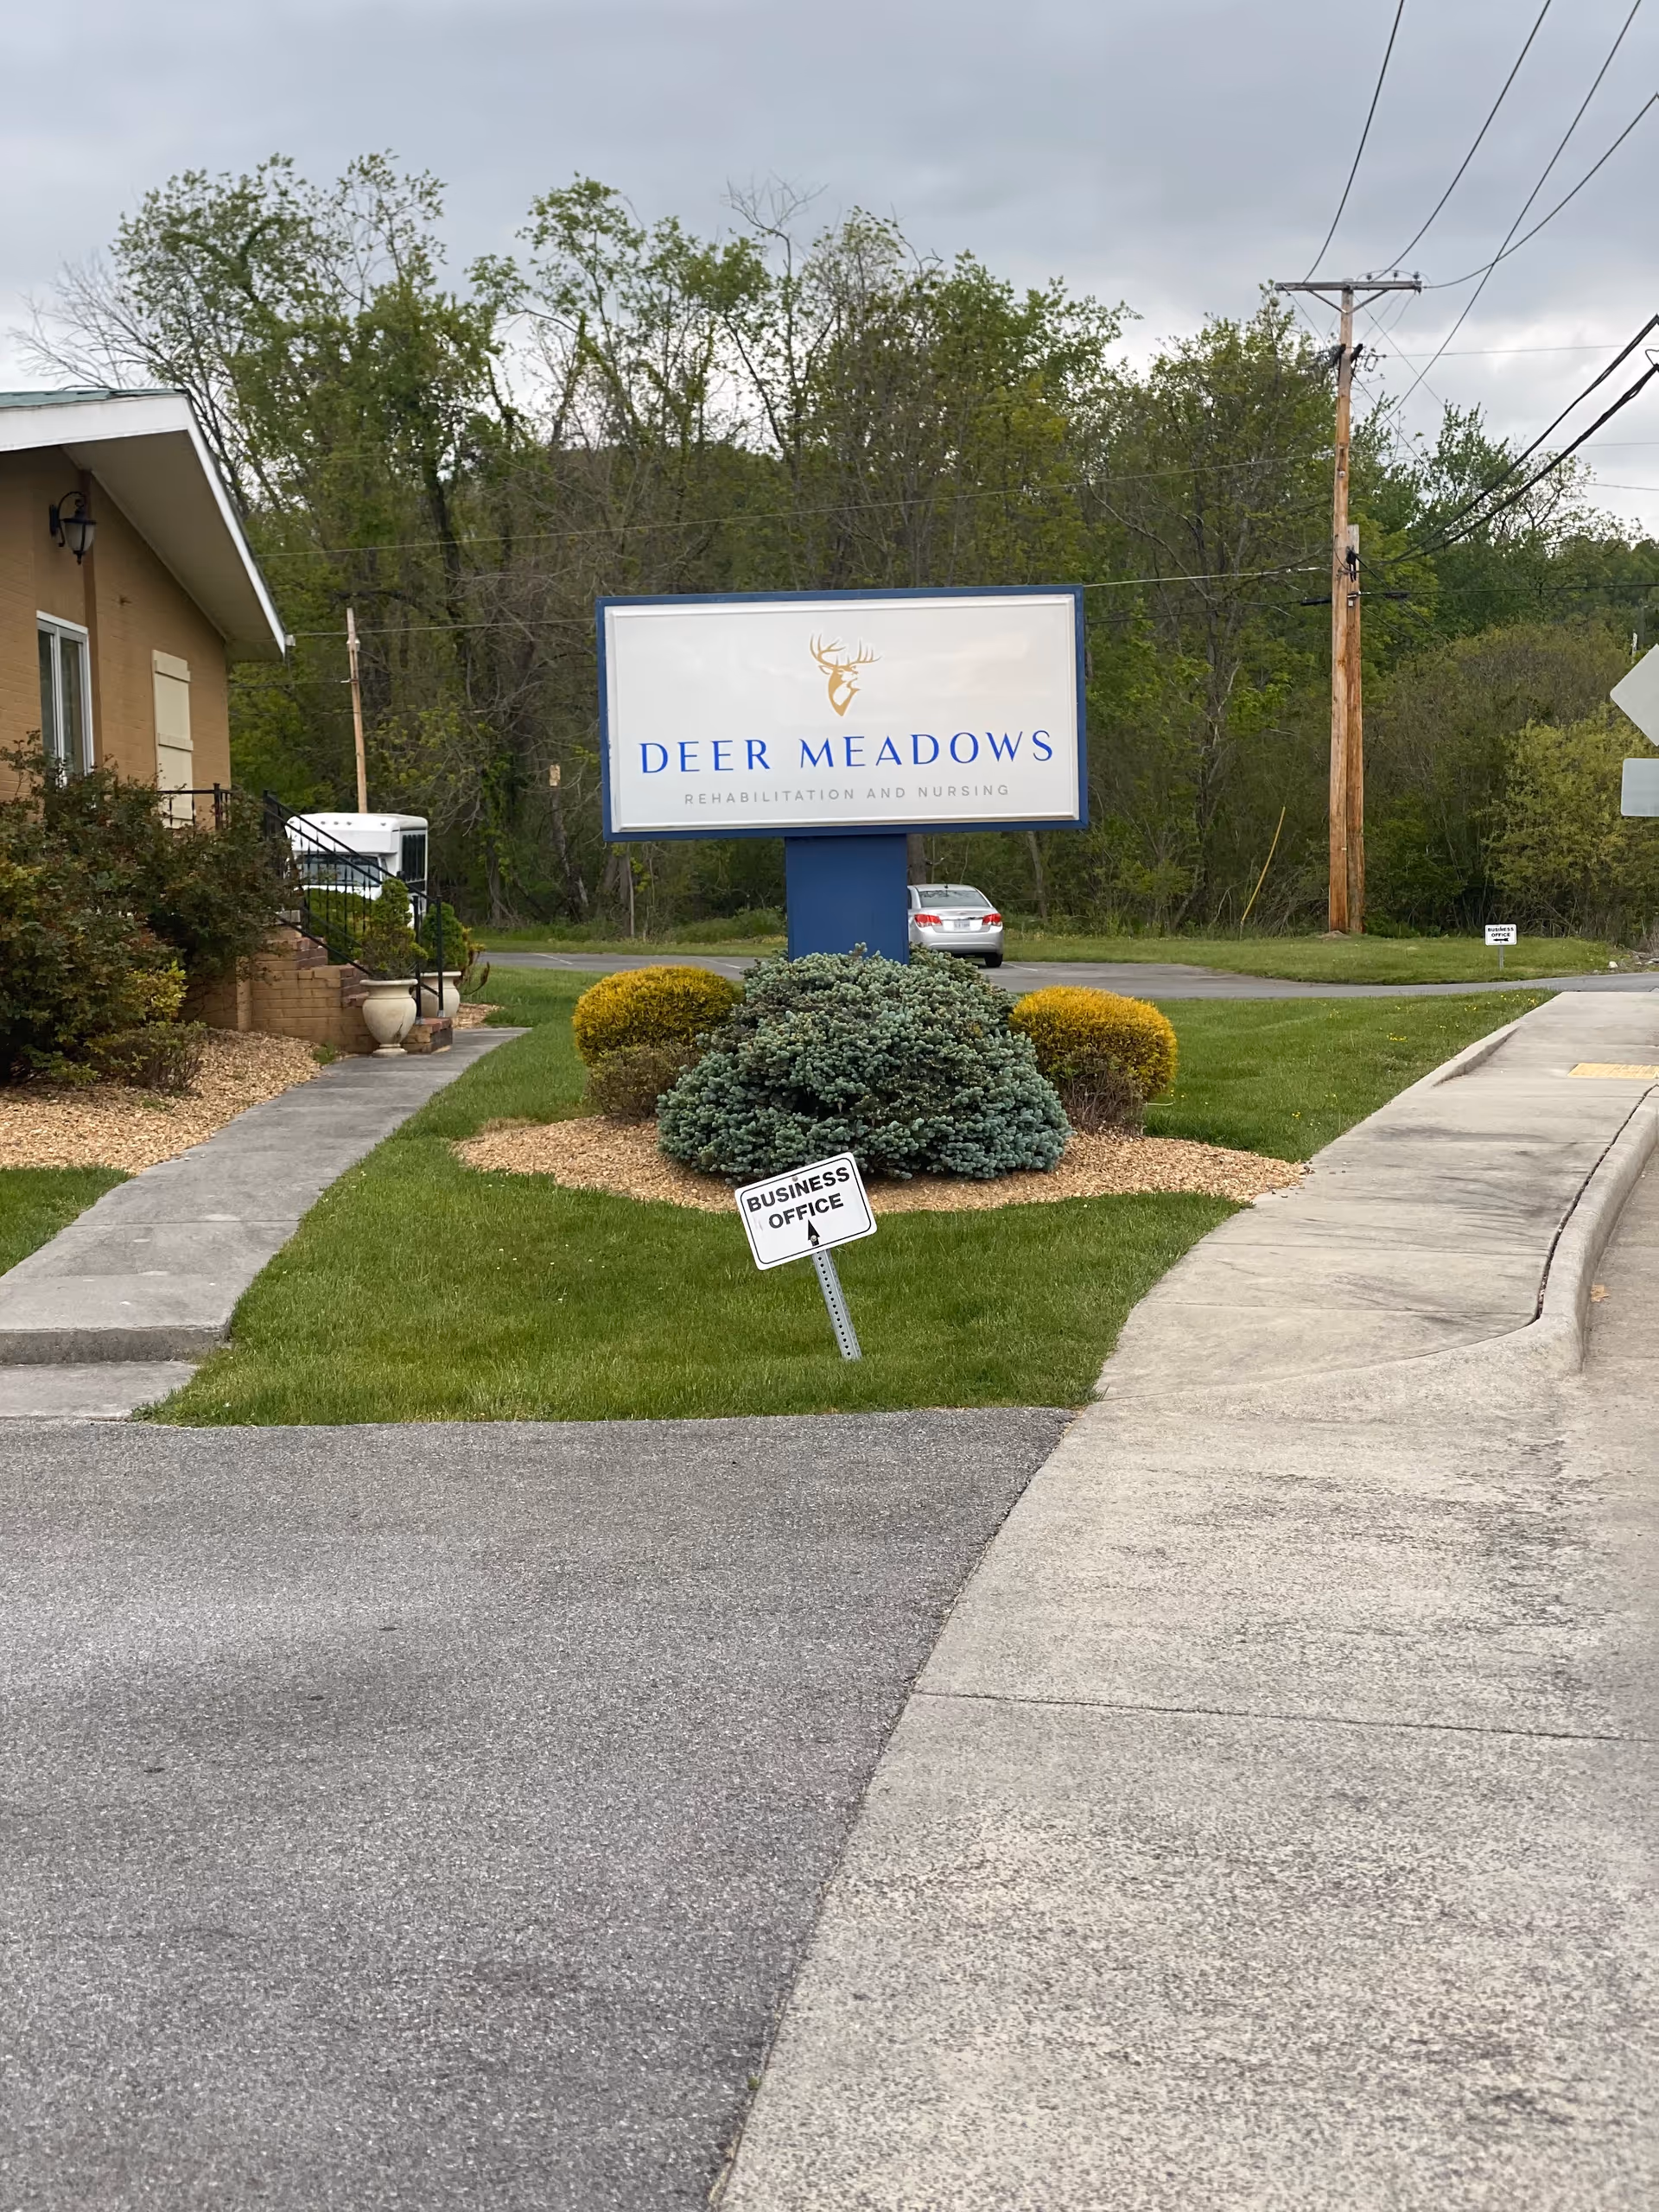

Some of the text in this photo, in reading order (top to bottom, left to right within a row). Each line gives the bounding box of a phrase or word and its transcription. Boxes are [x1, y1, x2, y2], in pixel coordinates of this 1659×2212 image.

[639, 730, 1053, 774] DEER MEADOWS
[684, 785, 1009, 804] REHABILITATION AND NURSING
[747, 1166, 850, 1213] BUSINESS
[768, 1192, 844, 1229] OFFICE
